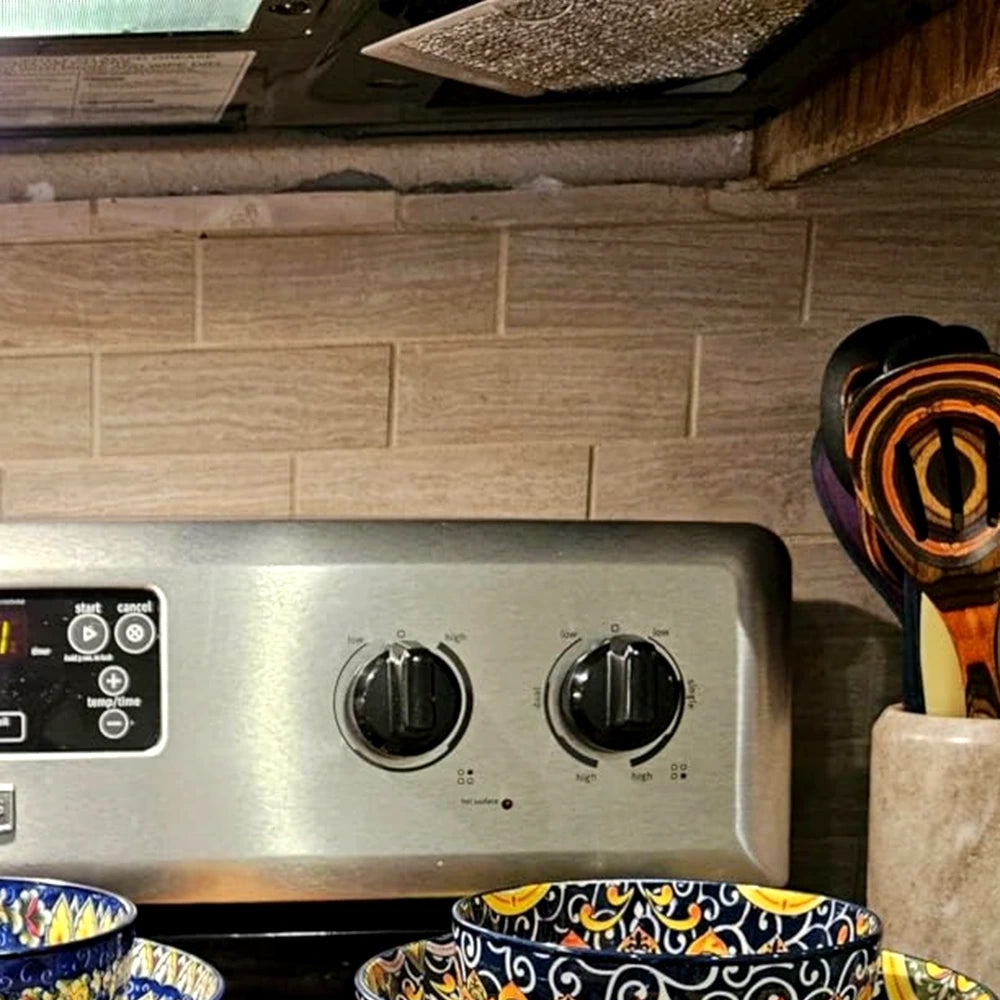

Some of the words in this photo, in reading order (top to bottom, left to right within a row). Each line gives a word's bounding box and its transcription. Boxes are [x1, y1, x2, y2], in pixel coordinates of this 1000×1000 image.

[75, 602, 102, 613] start
[117, 601, 153, 613] cancel
[445, 632, 466, 644] high
[560, 630, 577, 639] low
[653, 628, 670, 637] low
[86, 697, 142, 709] temp/time
[576, 774, 596, 784] high
[632, 772, 653, 783] high
